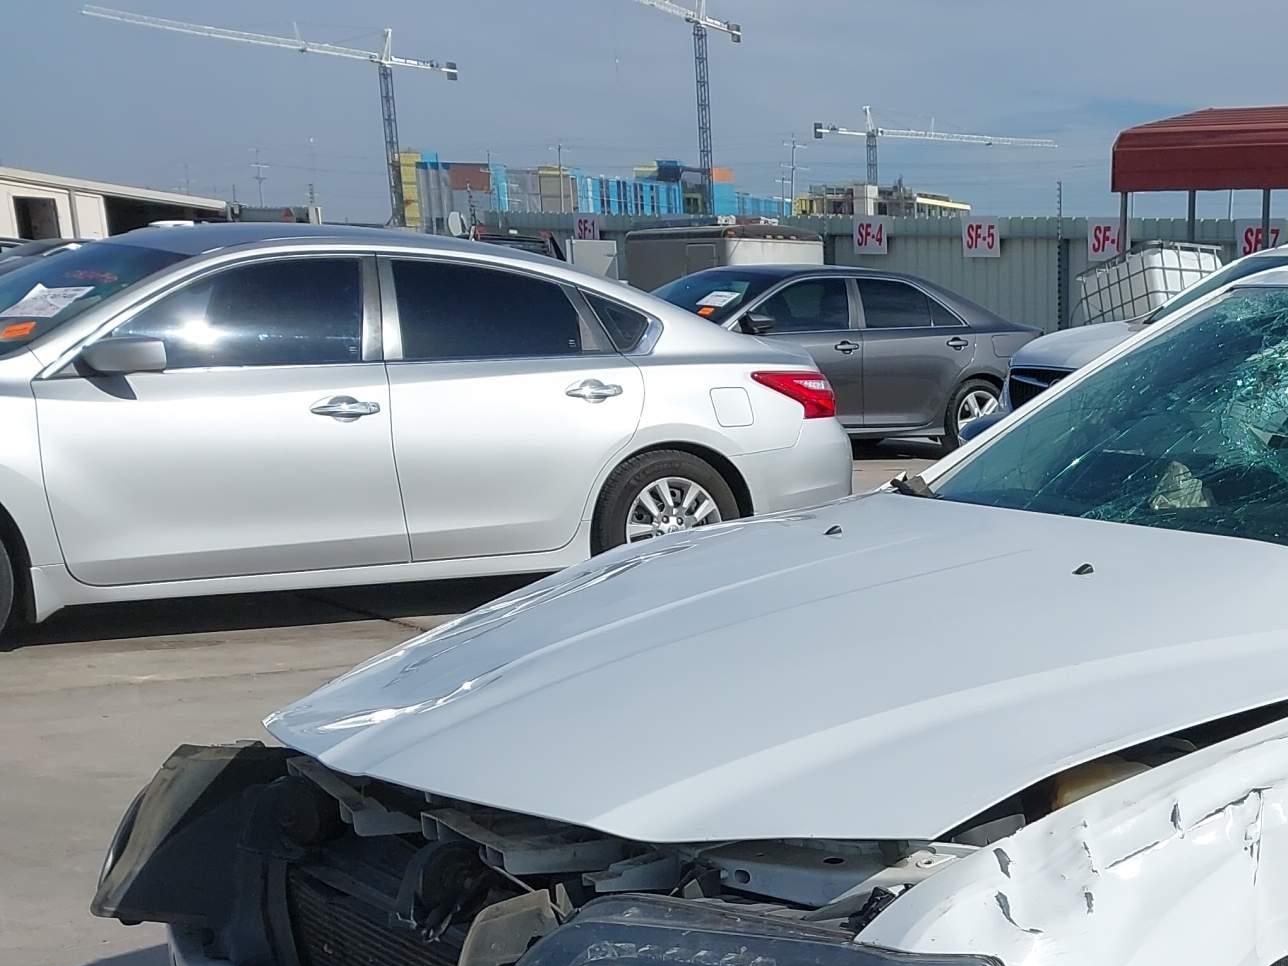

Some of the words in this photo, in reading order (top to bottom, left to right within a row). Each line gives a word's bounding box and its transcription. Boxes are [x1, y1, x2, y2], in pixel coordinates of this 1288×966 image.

[857, 223, 883, 246] SF-4
[966, 224, 995, 249] SF-5
[1092, 226, 1121, 253] SF-
